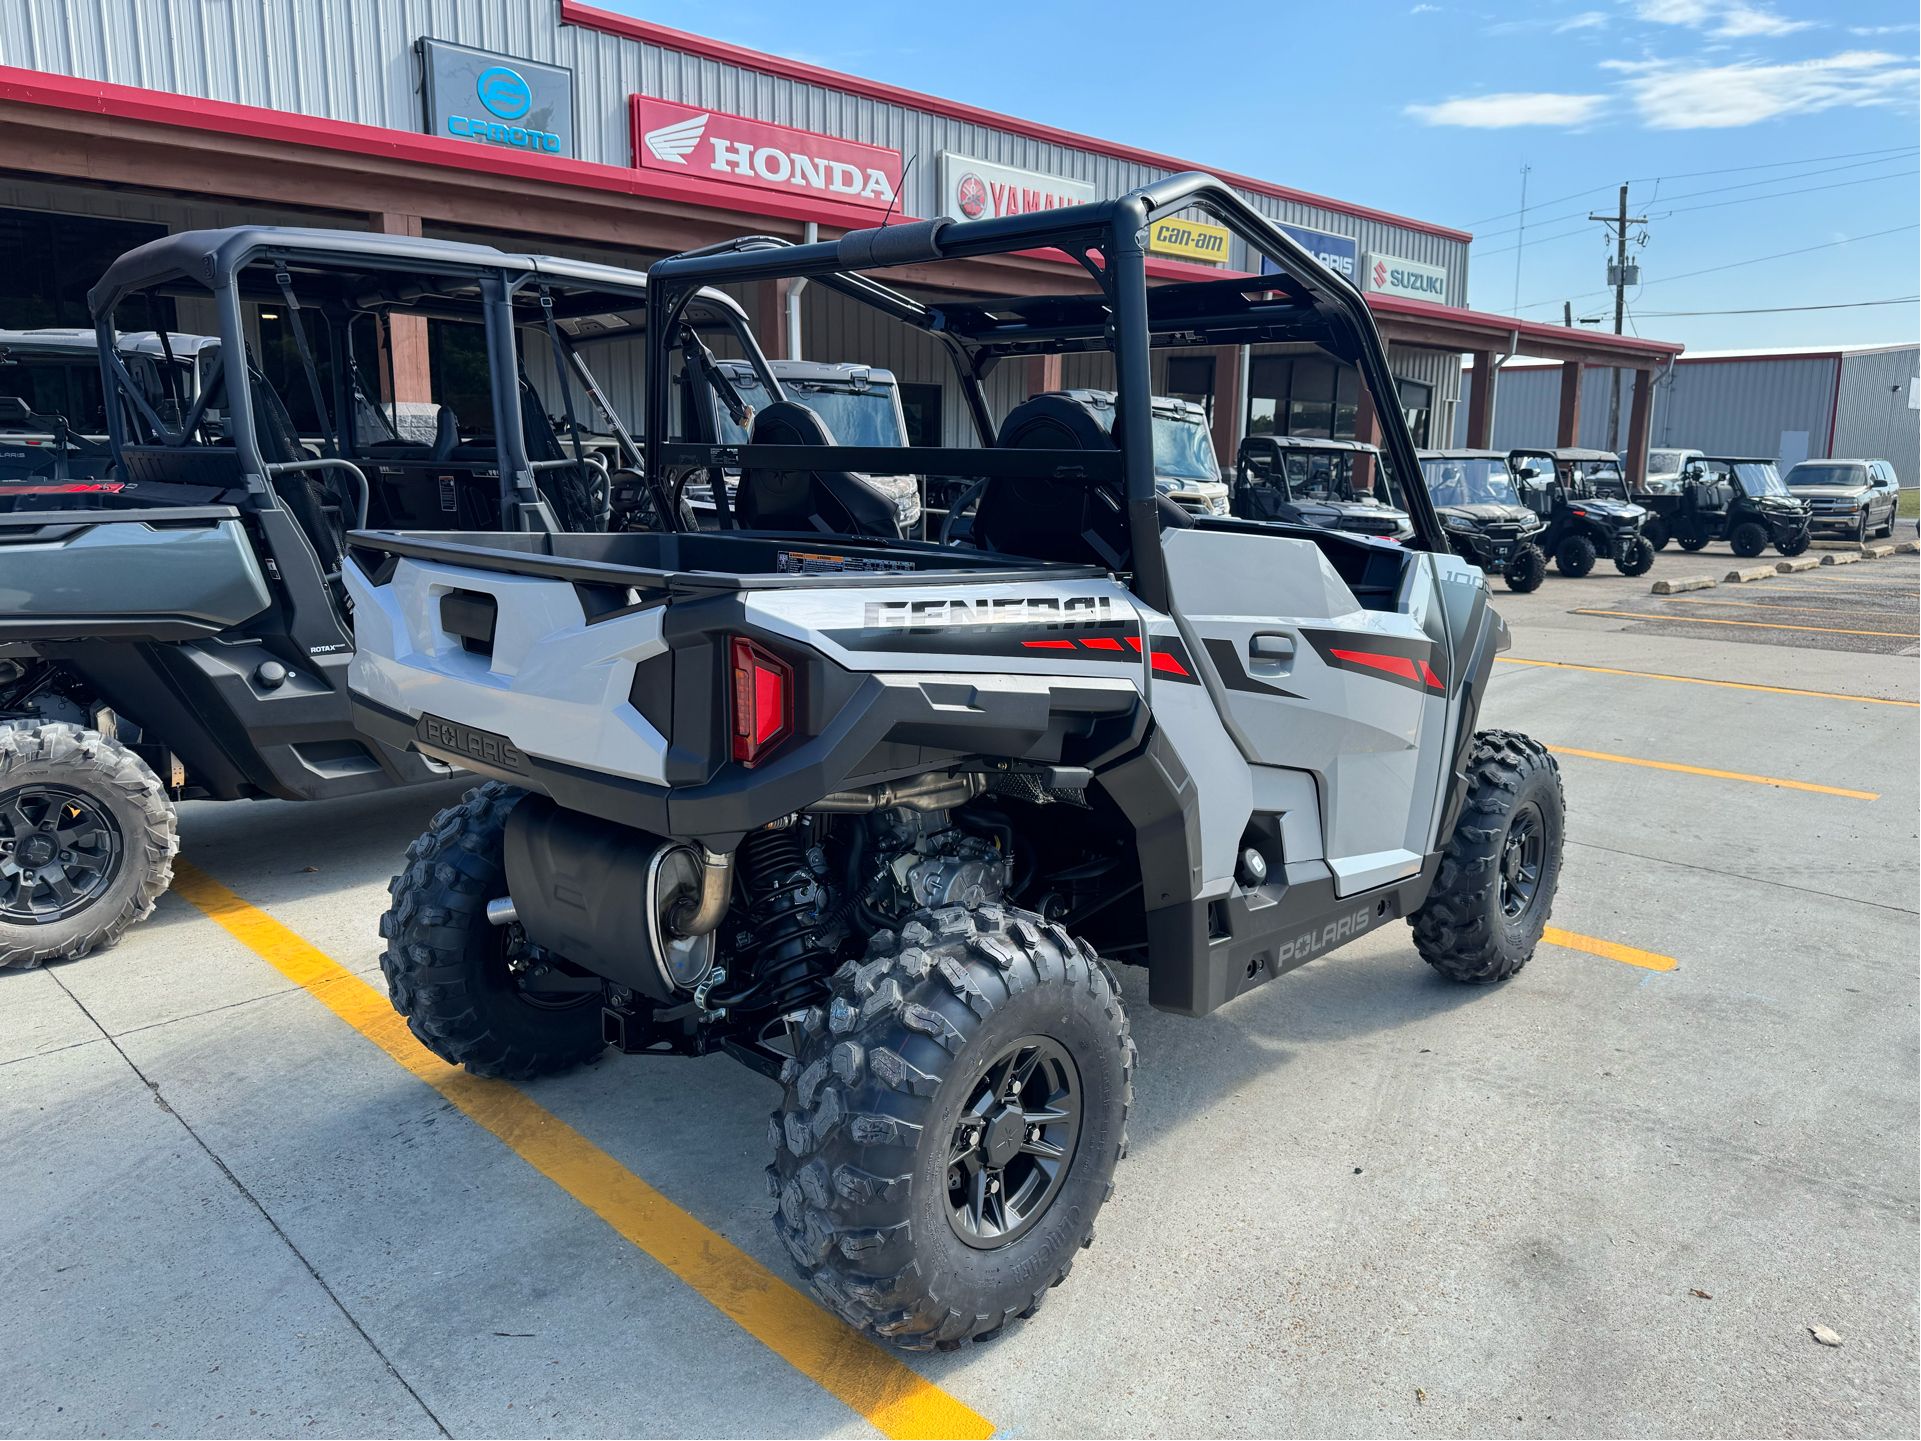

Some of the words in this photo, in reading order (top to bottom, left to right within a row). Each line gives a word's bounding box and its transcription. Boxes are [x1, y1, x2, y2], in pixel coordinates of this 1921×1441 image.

[448, 115, 561, 152] CFMOTO
[709, 136, 900, 203] HONDA
[990, 180, 1087, 218] YAMA
[1156, 225, 1224, 252] can-am
[1390, 268, 1444, 295] SUZUKI
[861, 596, 1126, 638] GENERAL
[310, 644, 336, 653] ROTAX
[426, 720, 519, 769] POLARIS
[1278, 906, 1371, 968] POLARIS
